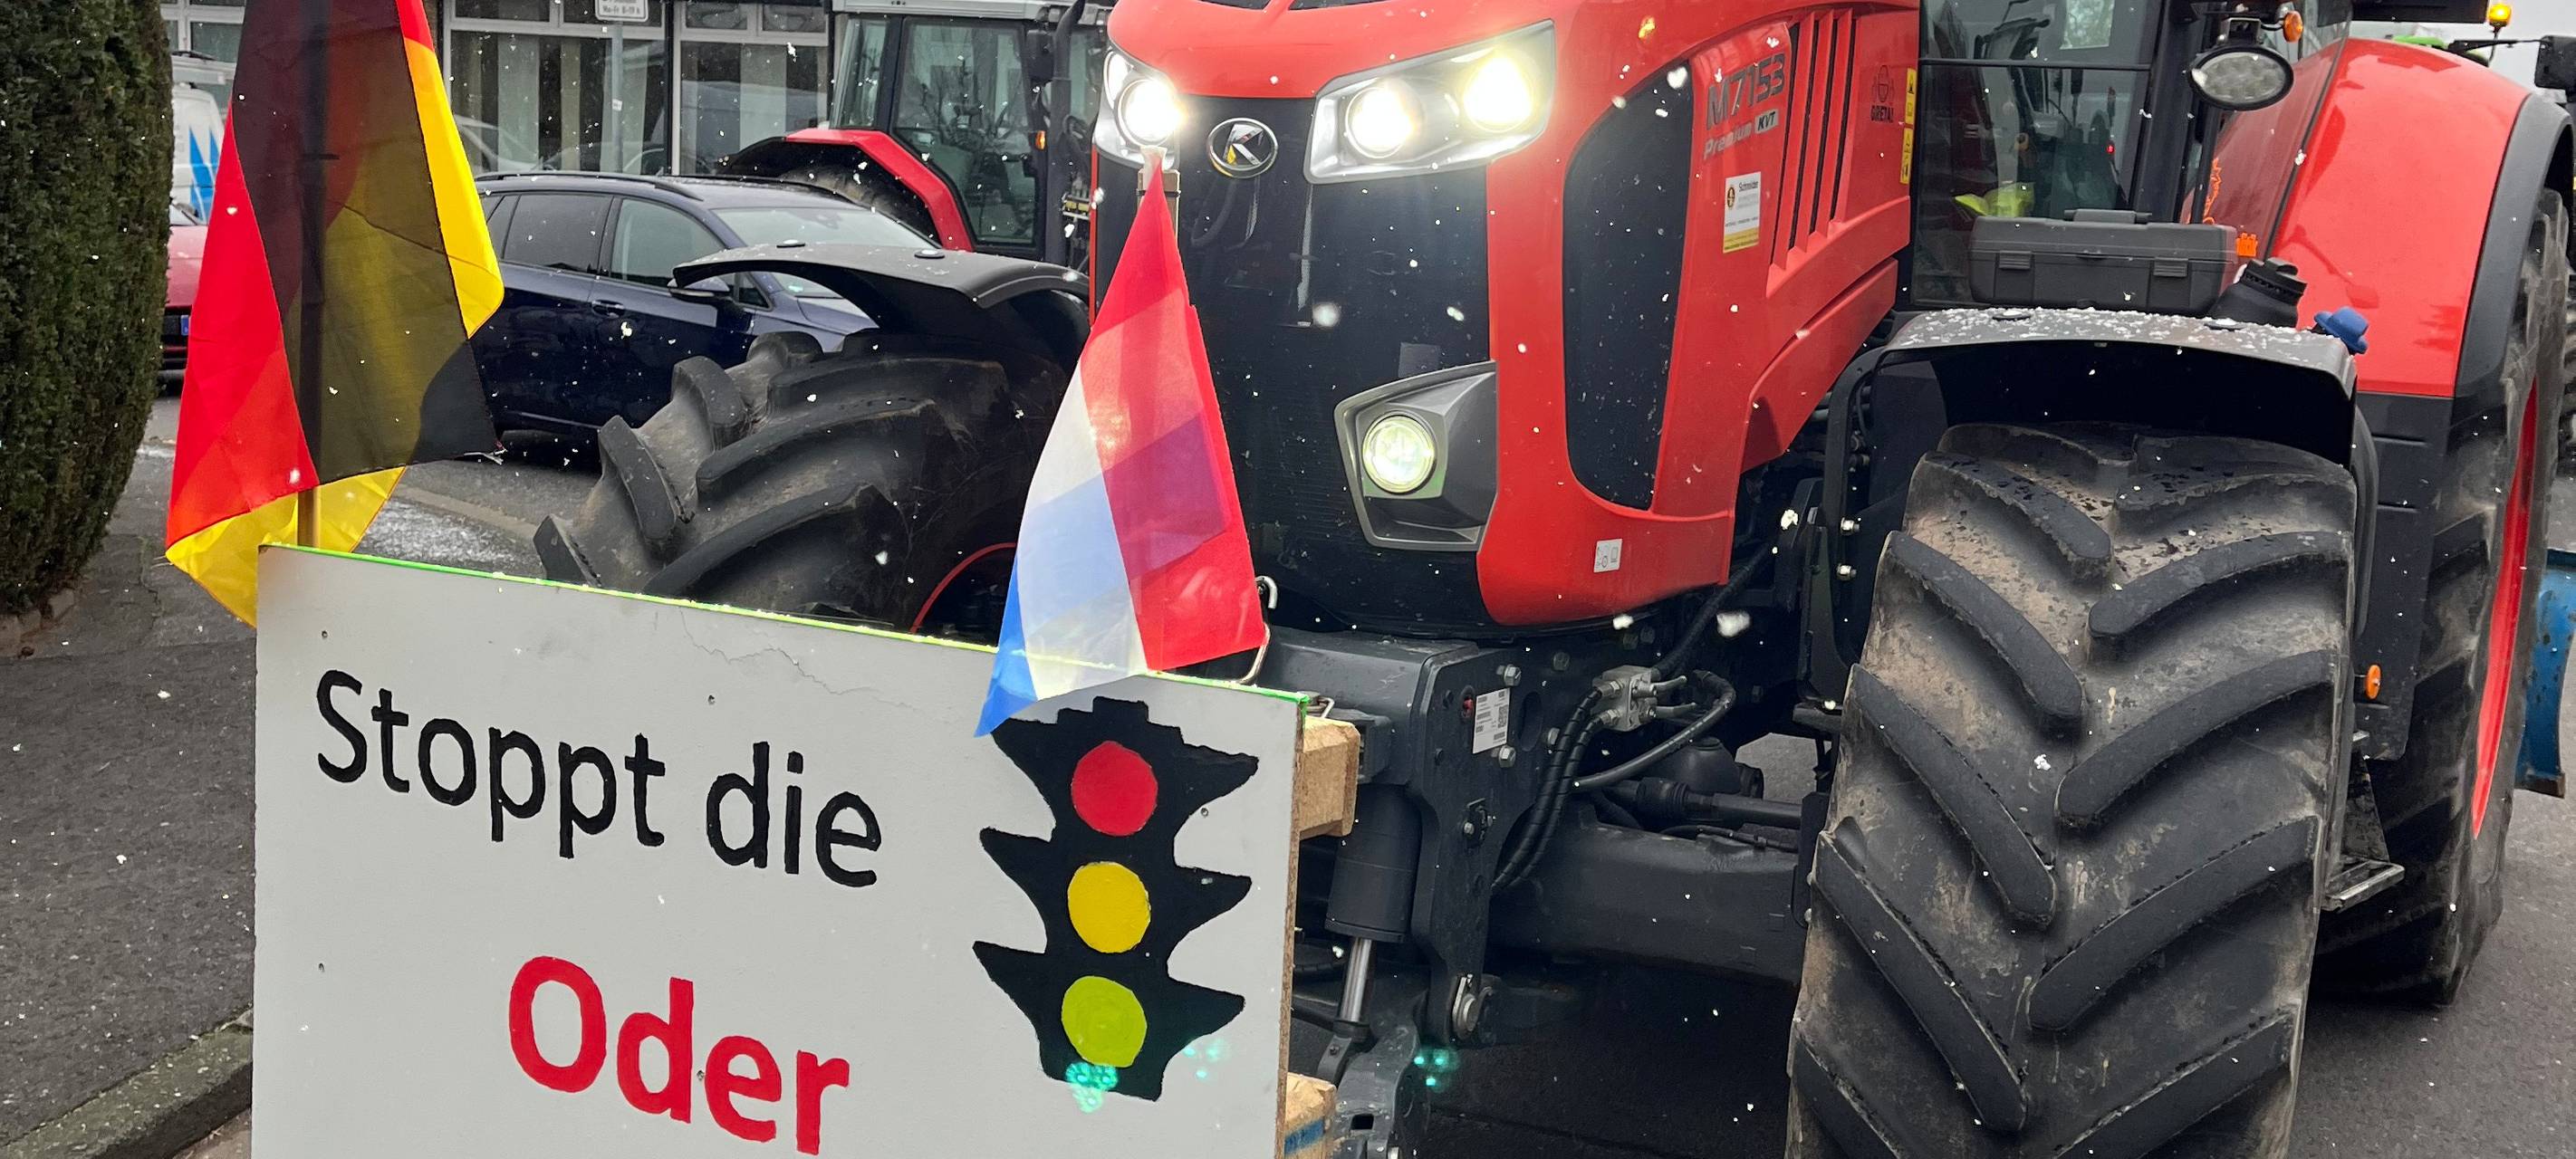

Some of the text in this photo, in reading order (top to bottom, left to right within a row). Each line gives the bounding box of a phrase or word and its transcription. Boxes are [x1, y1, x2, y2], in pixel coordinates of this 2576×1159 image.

[1706, 53, 1784, 130] M7153
[1757, 111, 1776, 131] KVT
[316, 669, 881, 887] Stoppt die
[508, 955, 850, 1155] Oder
